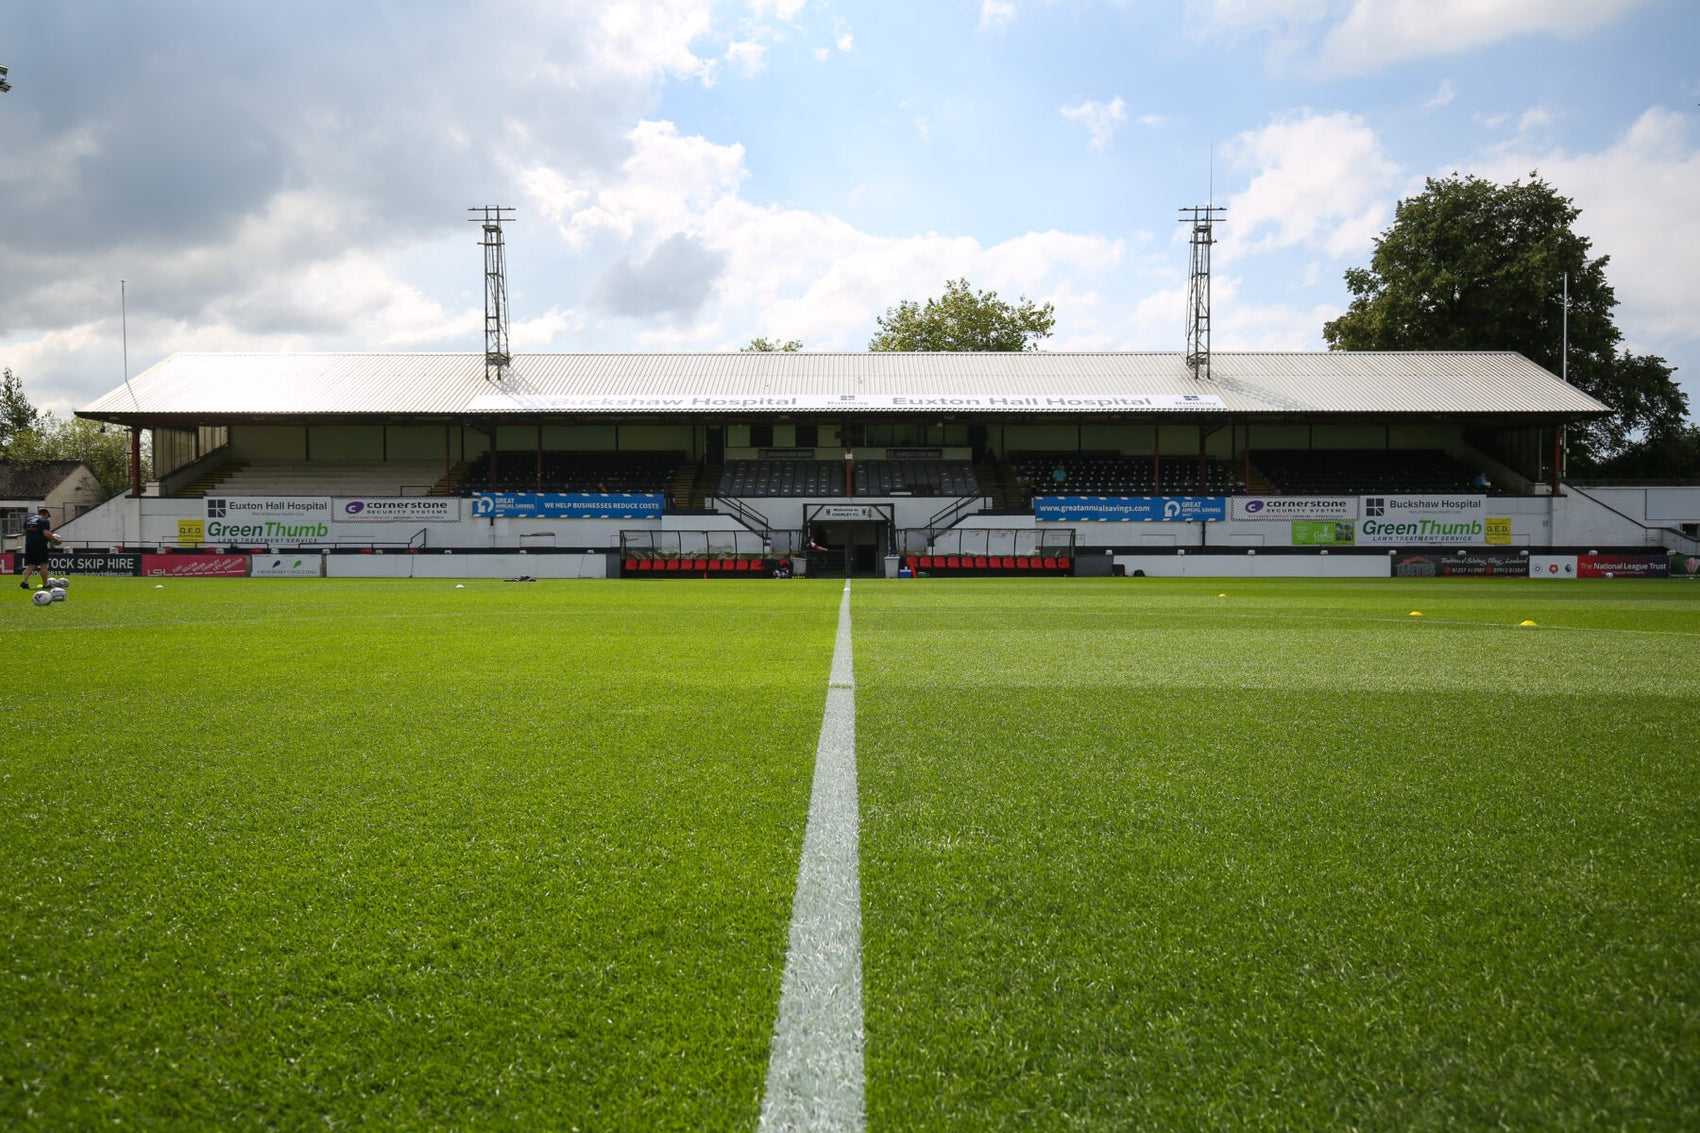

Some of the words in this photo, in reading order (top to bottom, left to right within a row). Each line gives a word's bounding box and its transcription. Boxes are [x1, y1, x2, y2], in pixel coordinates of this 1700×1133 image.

[692, 397, 797, 407] Hospital
[892, 397, 980, 406] Euxton
[989, 397, 1038, 406] Hall
[1046, 397, 1152, 407] Hospital
[229, 501, 263, 510] Euxton
[266, 501, 285, 510] Hall
[287, 501, 328, 512] Hospital
[367, 501, 448, 509] cornerstone
[1040, 503, 1150, 513] www.greatannualsavings.com
[1266, 500, 1347, 508] cornerstone
[1389, 500, 1439, 509] Buckshaw
[1441, 499, 1481, 510] Hospital
[208, 521, 328, 537] GreenThumb
[1362, 519, 1482, 536] GreenThumb
[77, 558, 104, 569] SKIP
[107, 558, 134, 569] HIRE
[1623, 562, 1648, 571] League
